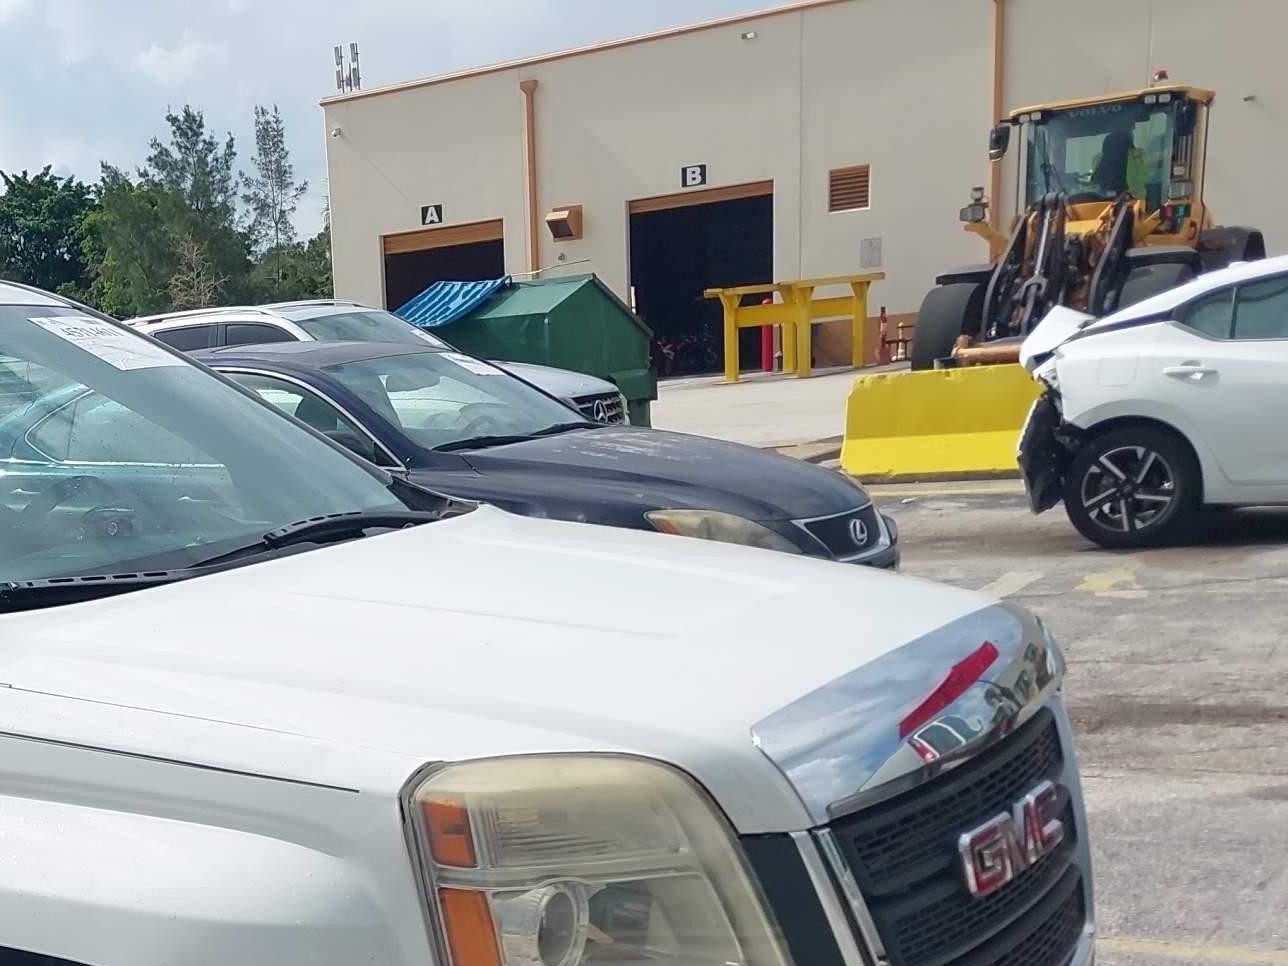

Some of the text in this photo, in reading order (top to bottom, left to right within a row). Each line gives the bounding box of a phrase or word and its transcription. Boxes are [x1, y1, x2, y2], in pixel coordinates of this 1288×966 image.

[686, 166, 703, 186] B
[424, 206, 440, 225] A
[959, 780, 1065, 897] GMC
